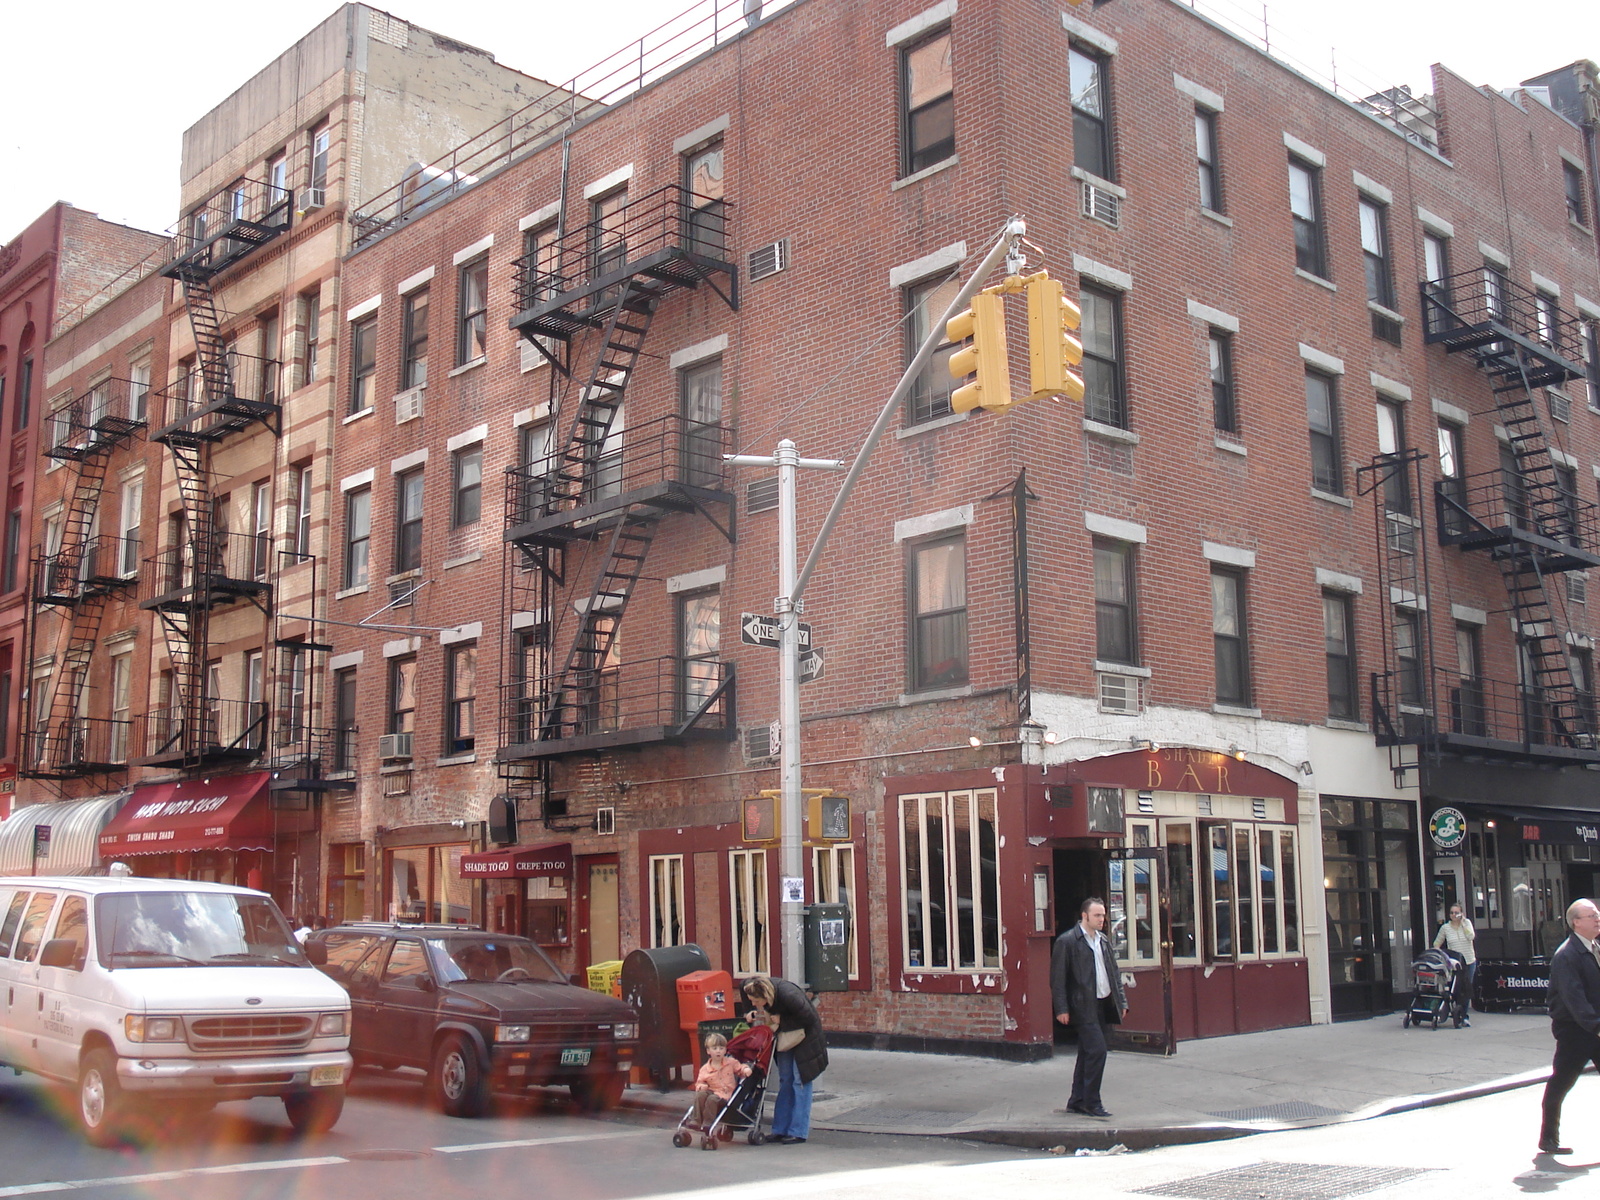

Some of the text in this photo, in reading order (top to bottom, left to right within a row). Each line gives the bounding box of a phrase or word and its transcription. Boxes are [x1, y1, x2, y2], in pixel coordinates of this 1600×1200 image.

[752, 624, 773, 638] ONE
[803, 658, 818, 673] WAY
[1147, 760, 1231, 793] BAR
[160, 799, 194, 816] MOTO
[190, 796, 228, 813] SUSHI
[1433, 809, 1461, 821] BROOKLYN
[142, 831, 158, 841] SHABU
[158, 830, 175, 840] SHABU
[1523, 825, 1539, 840] BAR
[1434, 835, 1461, 846] BREWERY
[465, 861, 509, 872] SHADE TO GO
[516, 861, 565, 870] CREPE TO GO
[1507, 976, 1549, 988] Heineke
